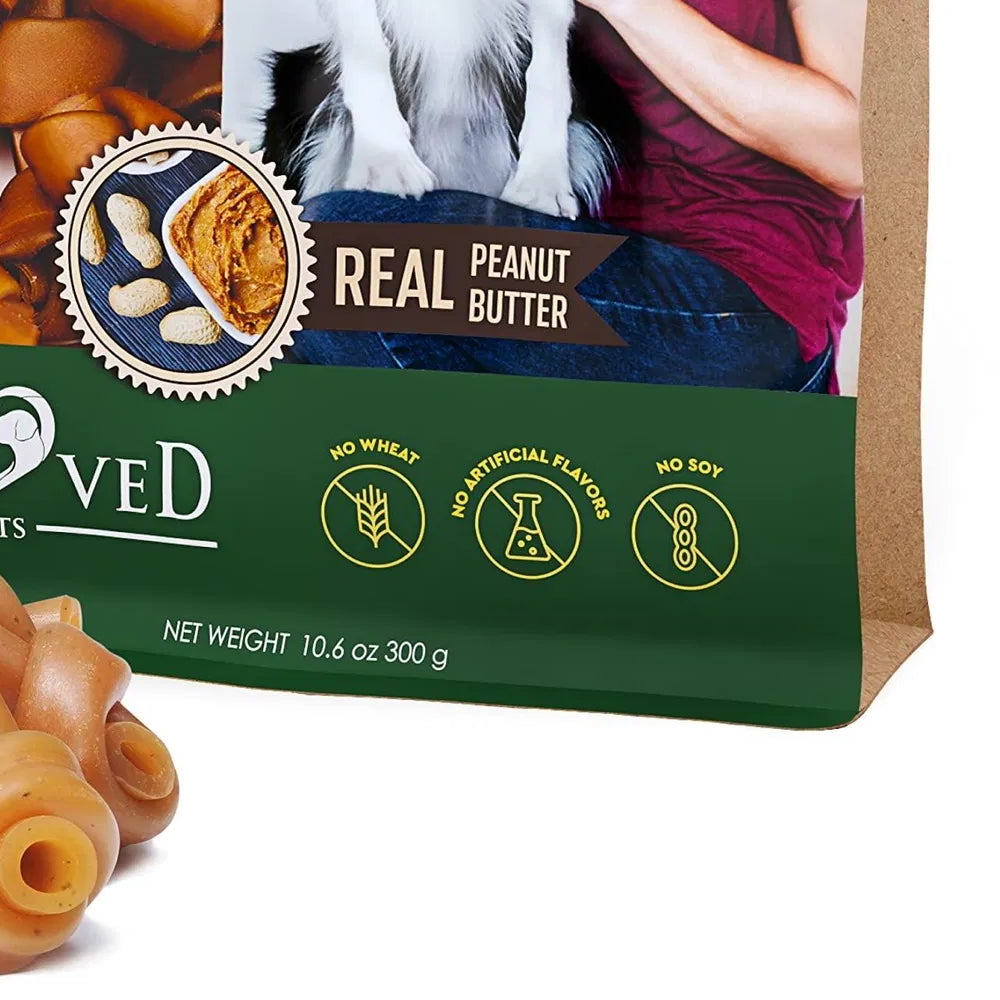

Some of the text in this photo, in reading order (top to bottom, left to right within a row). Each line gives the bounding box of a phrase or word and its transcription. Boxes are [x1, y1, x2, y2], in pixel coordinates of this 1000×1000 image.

[334, 246, 454, 310] REAL
[470, 242, 571, 284] PEANUT
[468, 288, 568, 329] BUTTER
[330, 438, 421, 466] NO WHEAT
[655, 457, 725, 480] NO SOY
[451, 447, 611, 521] NO ARTIFICIAL FLAVORS
[163, 619, 449, 671] NET WEIGHT 10.6 oz 300 g
